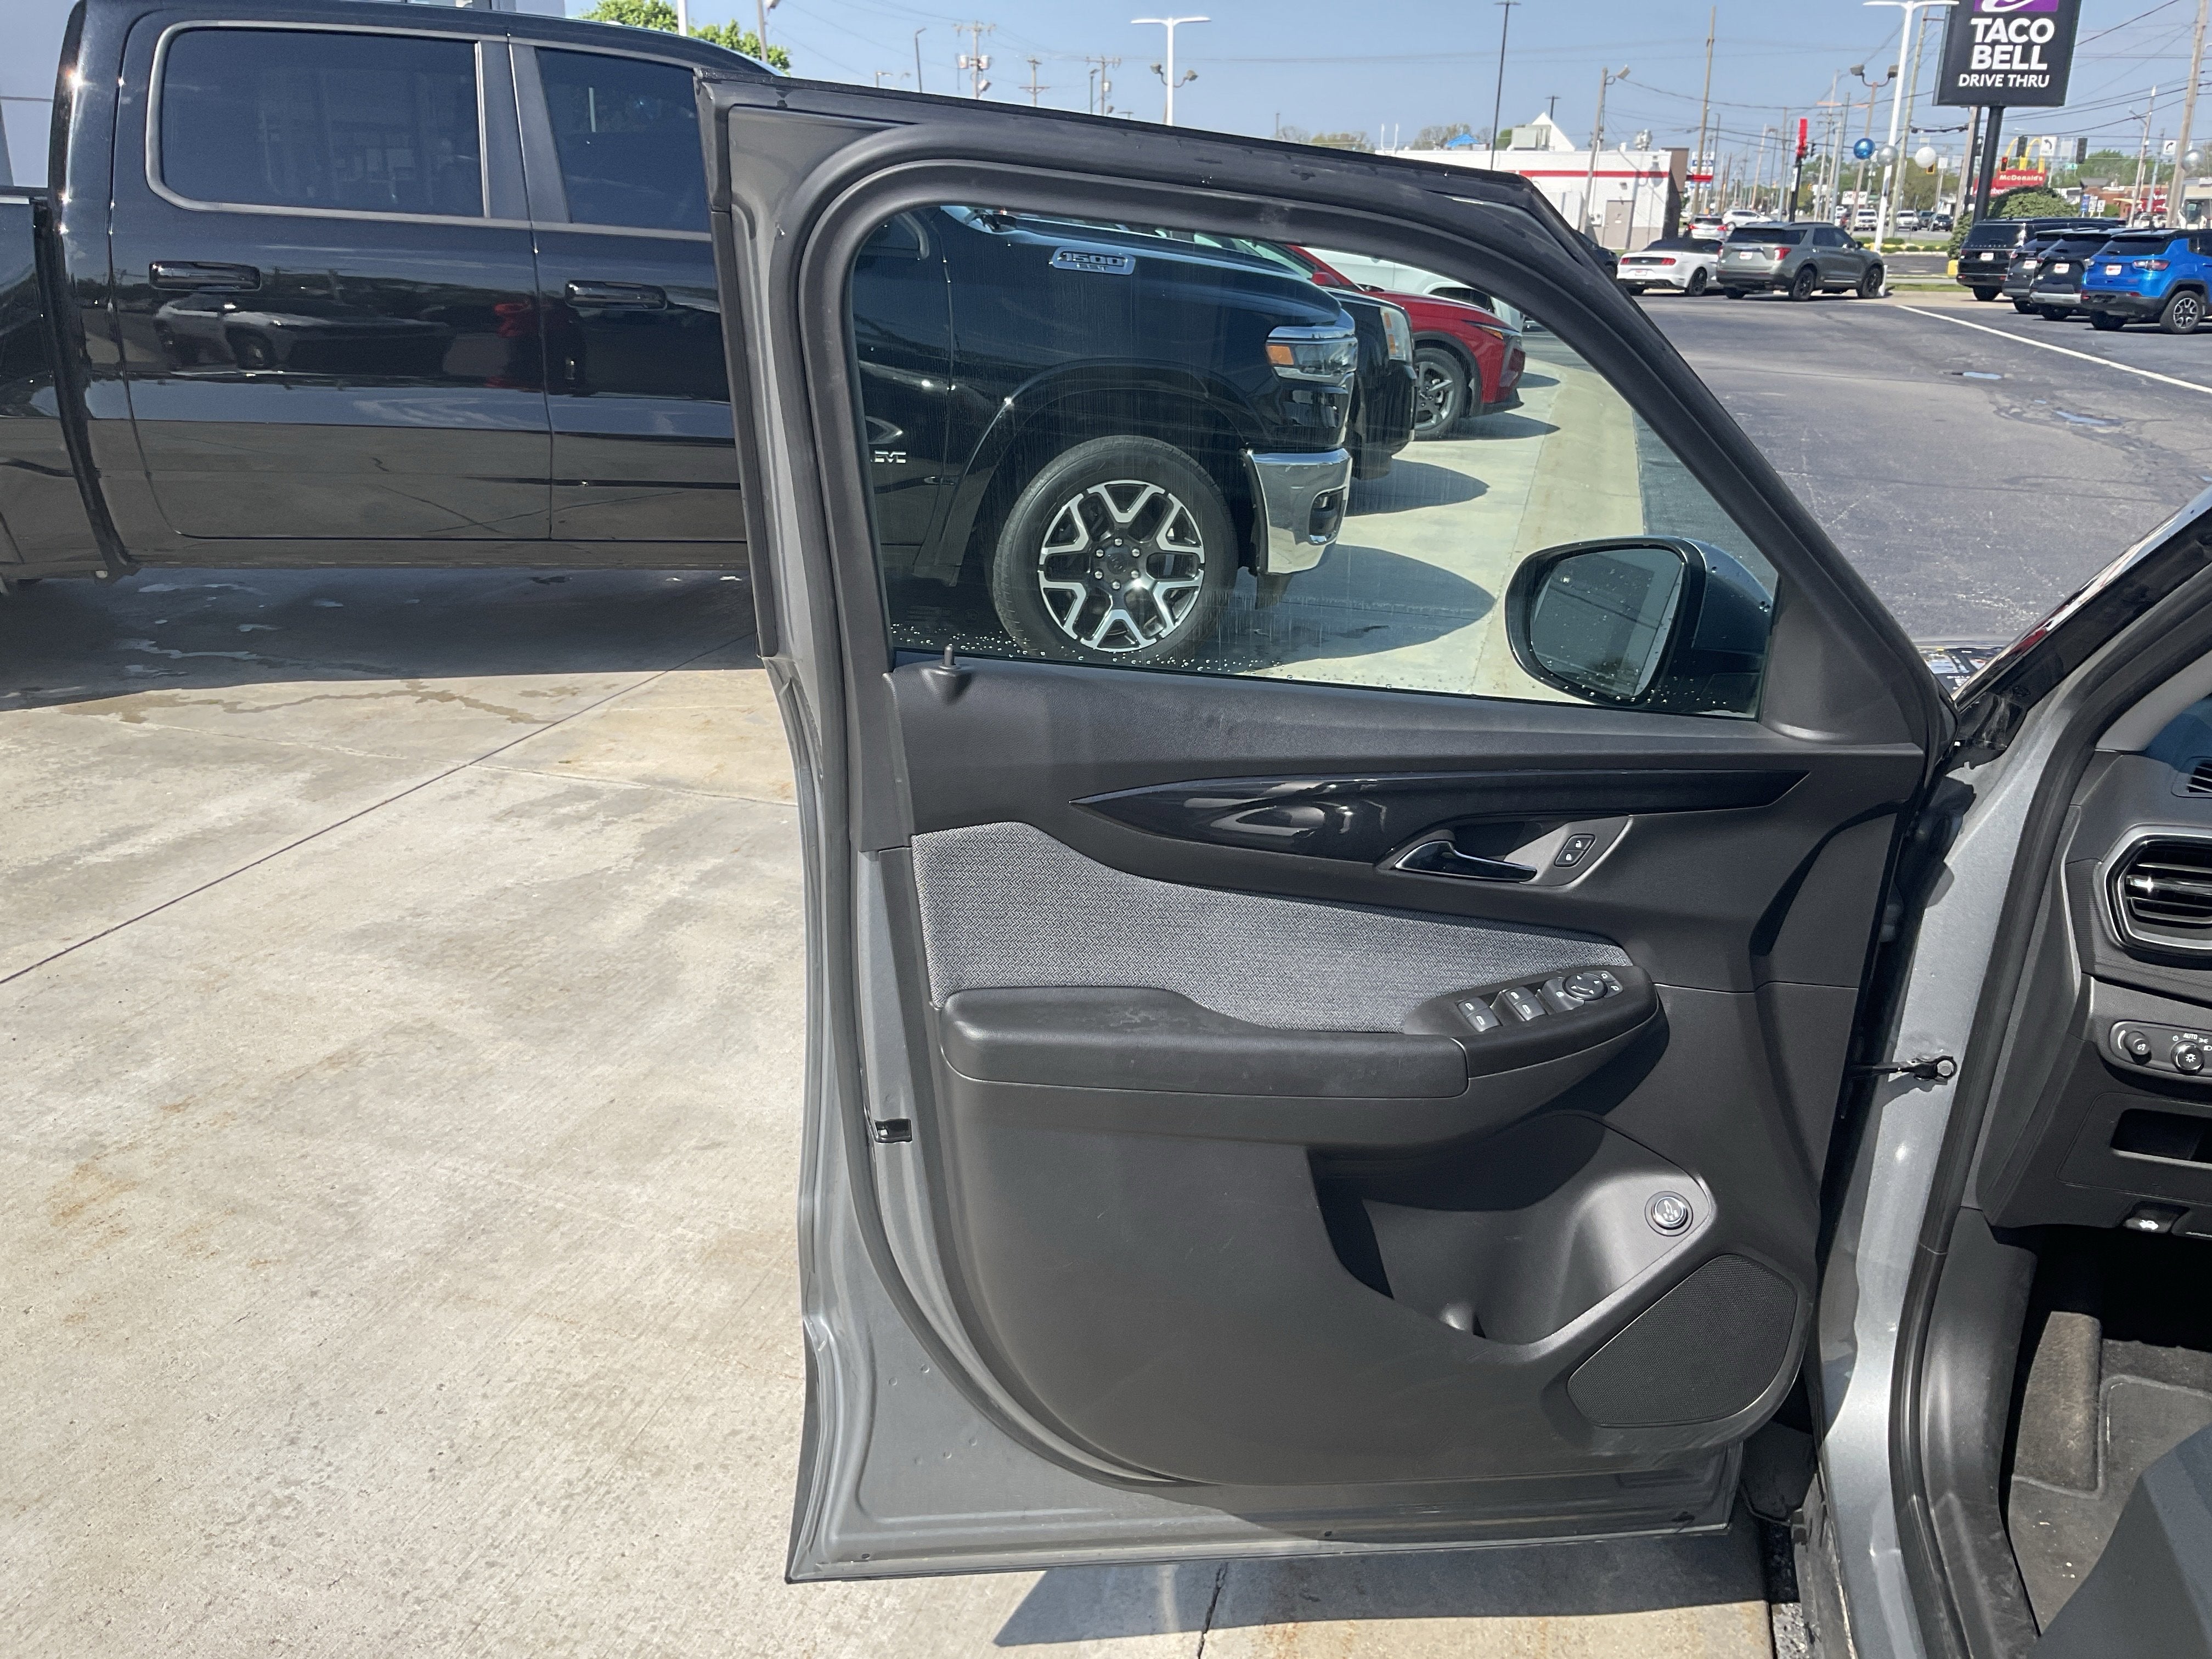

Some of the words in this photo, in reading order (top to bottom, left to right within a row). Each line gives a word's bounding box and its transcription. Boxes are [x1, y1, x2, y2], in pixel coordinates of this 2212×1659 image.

[1971, 18, 2056, 43] TACO
[1971, 44, 2048, 70] BELL
[1958, 74, 2005, 87] DRIVE
[2007, 74, 2050, 88] THRU
[1063, 252, 1124, 267] 1500
